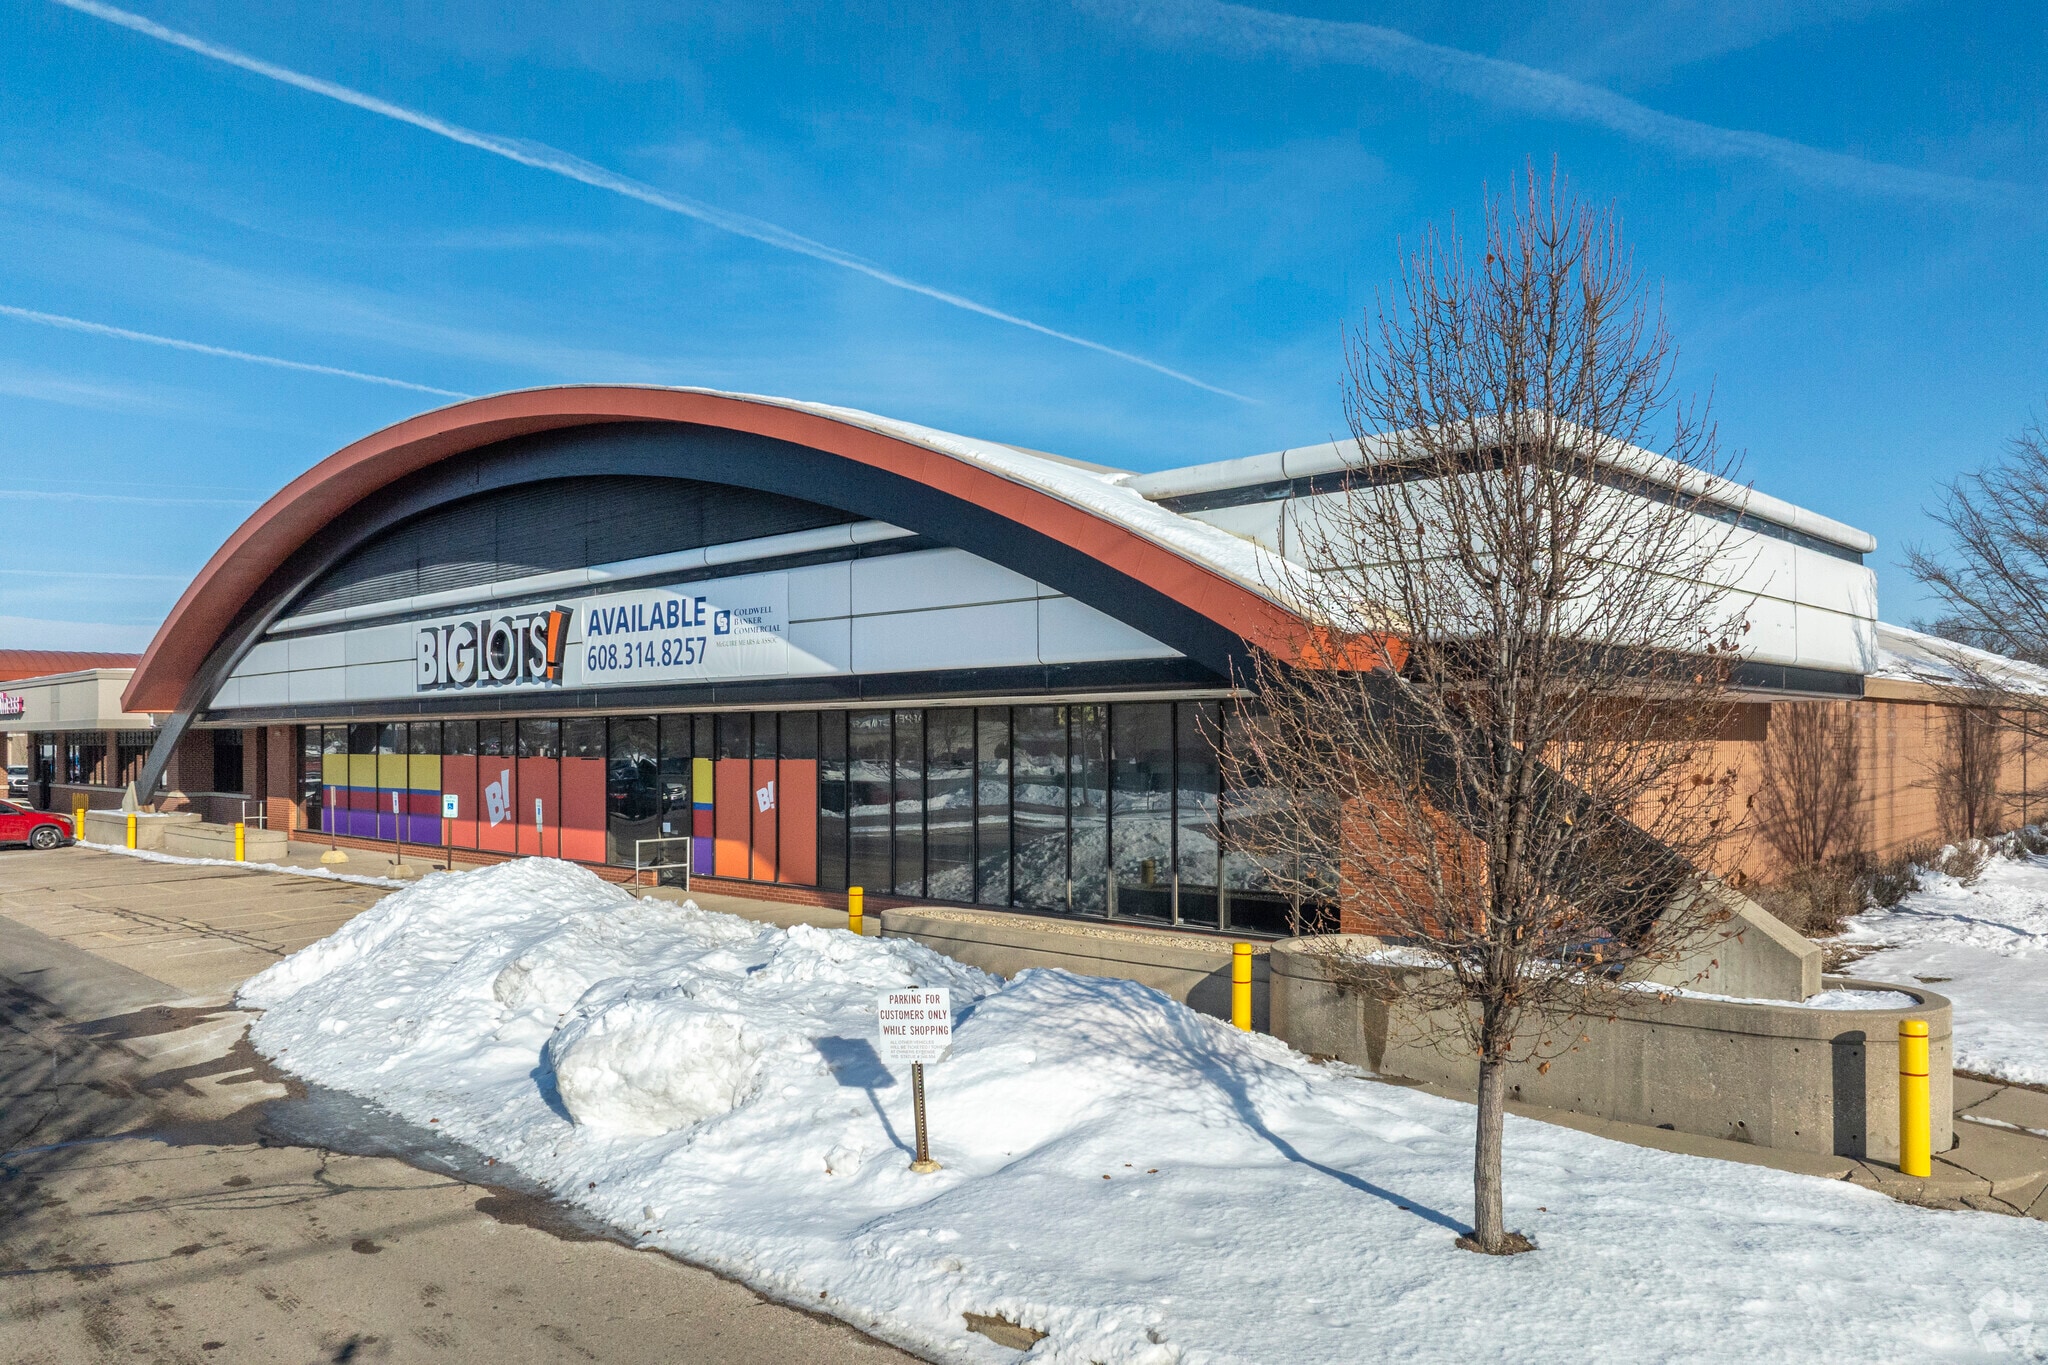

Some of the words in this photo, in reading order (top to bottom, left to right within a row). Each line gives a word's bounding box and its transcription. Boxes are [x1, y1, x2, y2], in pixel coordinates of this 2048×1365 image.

[734, 606, 773, 616] COLDWELL
[588, 596, 707, 637] AVAILABLE
[734, 617, 762, 625] BANKER
[734, 624, 781, 635] COMMERCIAL
[588, 636, 707, 671] 608.314.8257
[889, 994, 921, 1004] PARKING
[925, 994, 941, 1004] FOR
[880, 1010, 924, 1020] CUSTOMERS
[928, 1010, 947, 1020] ONLY
[883, 1025, 906, 1035] WHILE
[910, 1025, 949, 1035] SHOPPING
